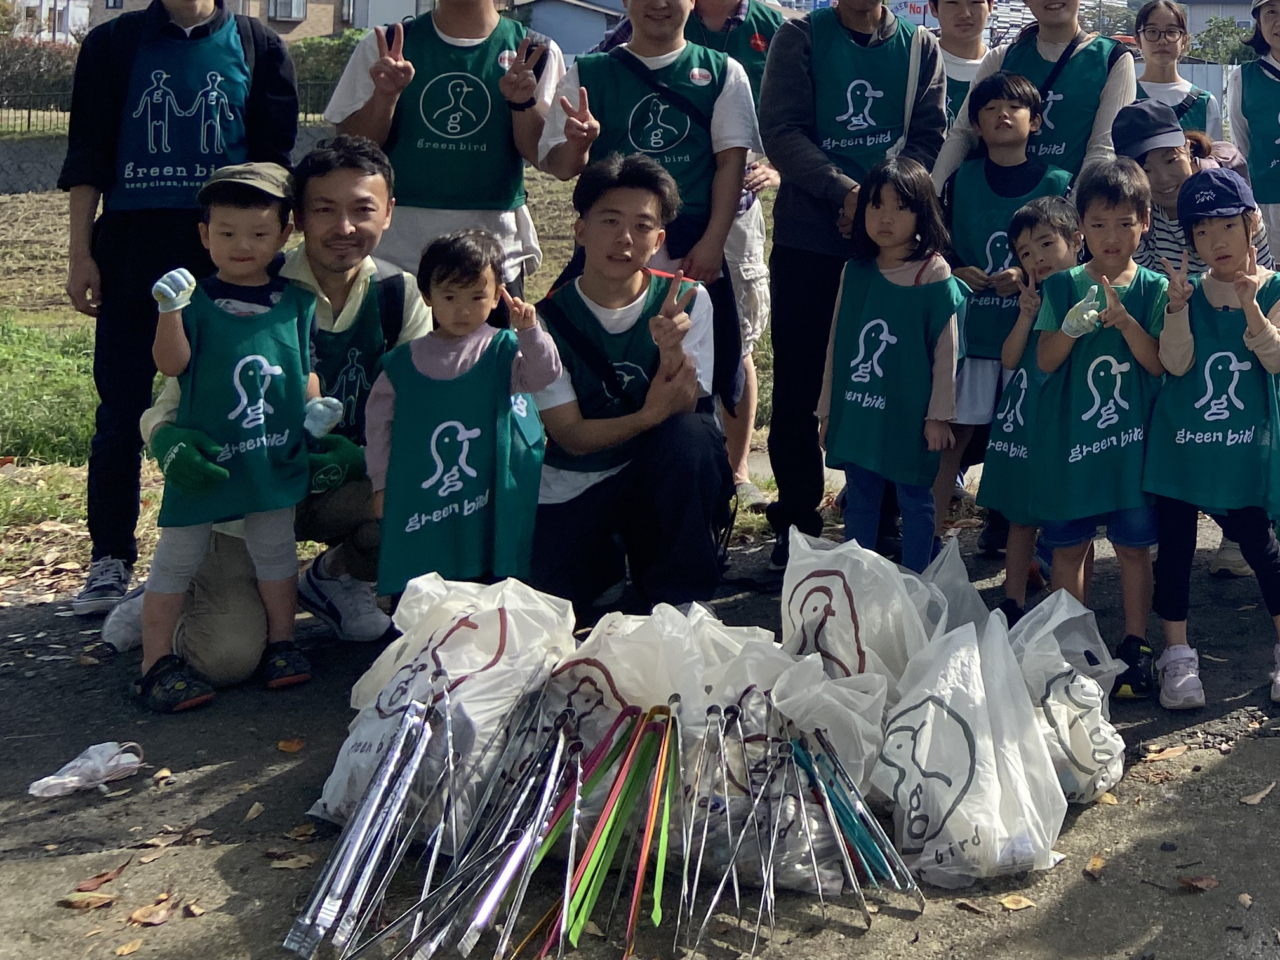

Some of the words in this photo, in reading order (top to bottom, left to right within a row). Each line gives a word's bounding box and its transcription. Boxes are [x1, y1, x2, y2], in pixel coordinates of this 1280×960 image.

[416, 138, 457, 151] green
[459, 141, 487, 152] bird
[820, 136, 864, 150] green
[866, 130, 892, 147] bird
[1037, 141, 1066, 156] bird
[664, 153, 691, 163] bird
[124, 161, 188, 179] green
[194, 163, 216, 178] bi
[970, 295, 1000, 306] reen
[1001, 296, 1021, 309] bi
[862, 391, 887, 410] bird
[1068, 435, 1118, 463] green
[1120, 423, 1145, 448] bird
[1175, 428, 1223, 445] green
[1226, 424, 1255, 447] bird
[405, 502, 460, 533] green
[934, 824, 982, 865] bird
